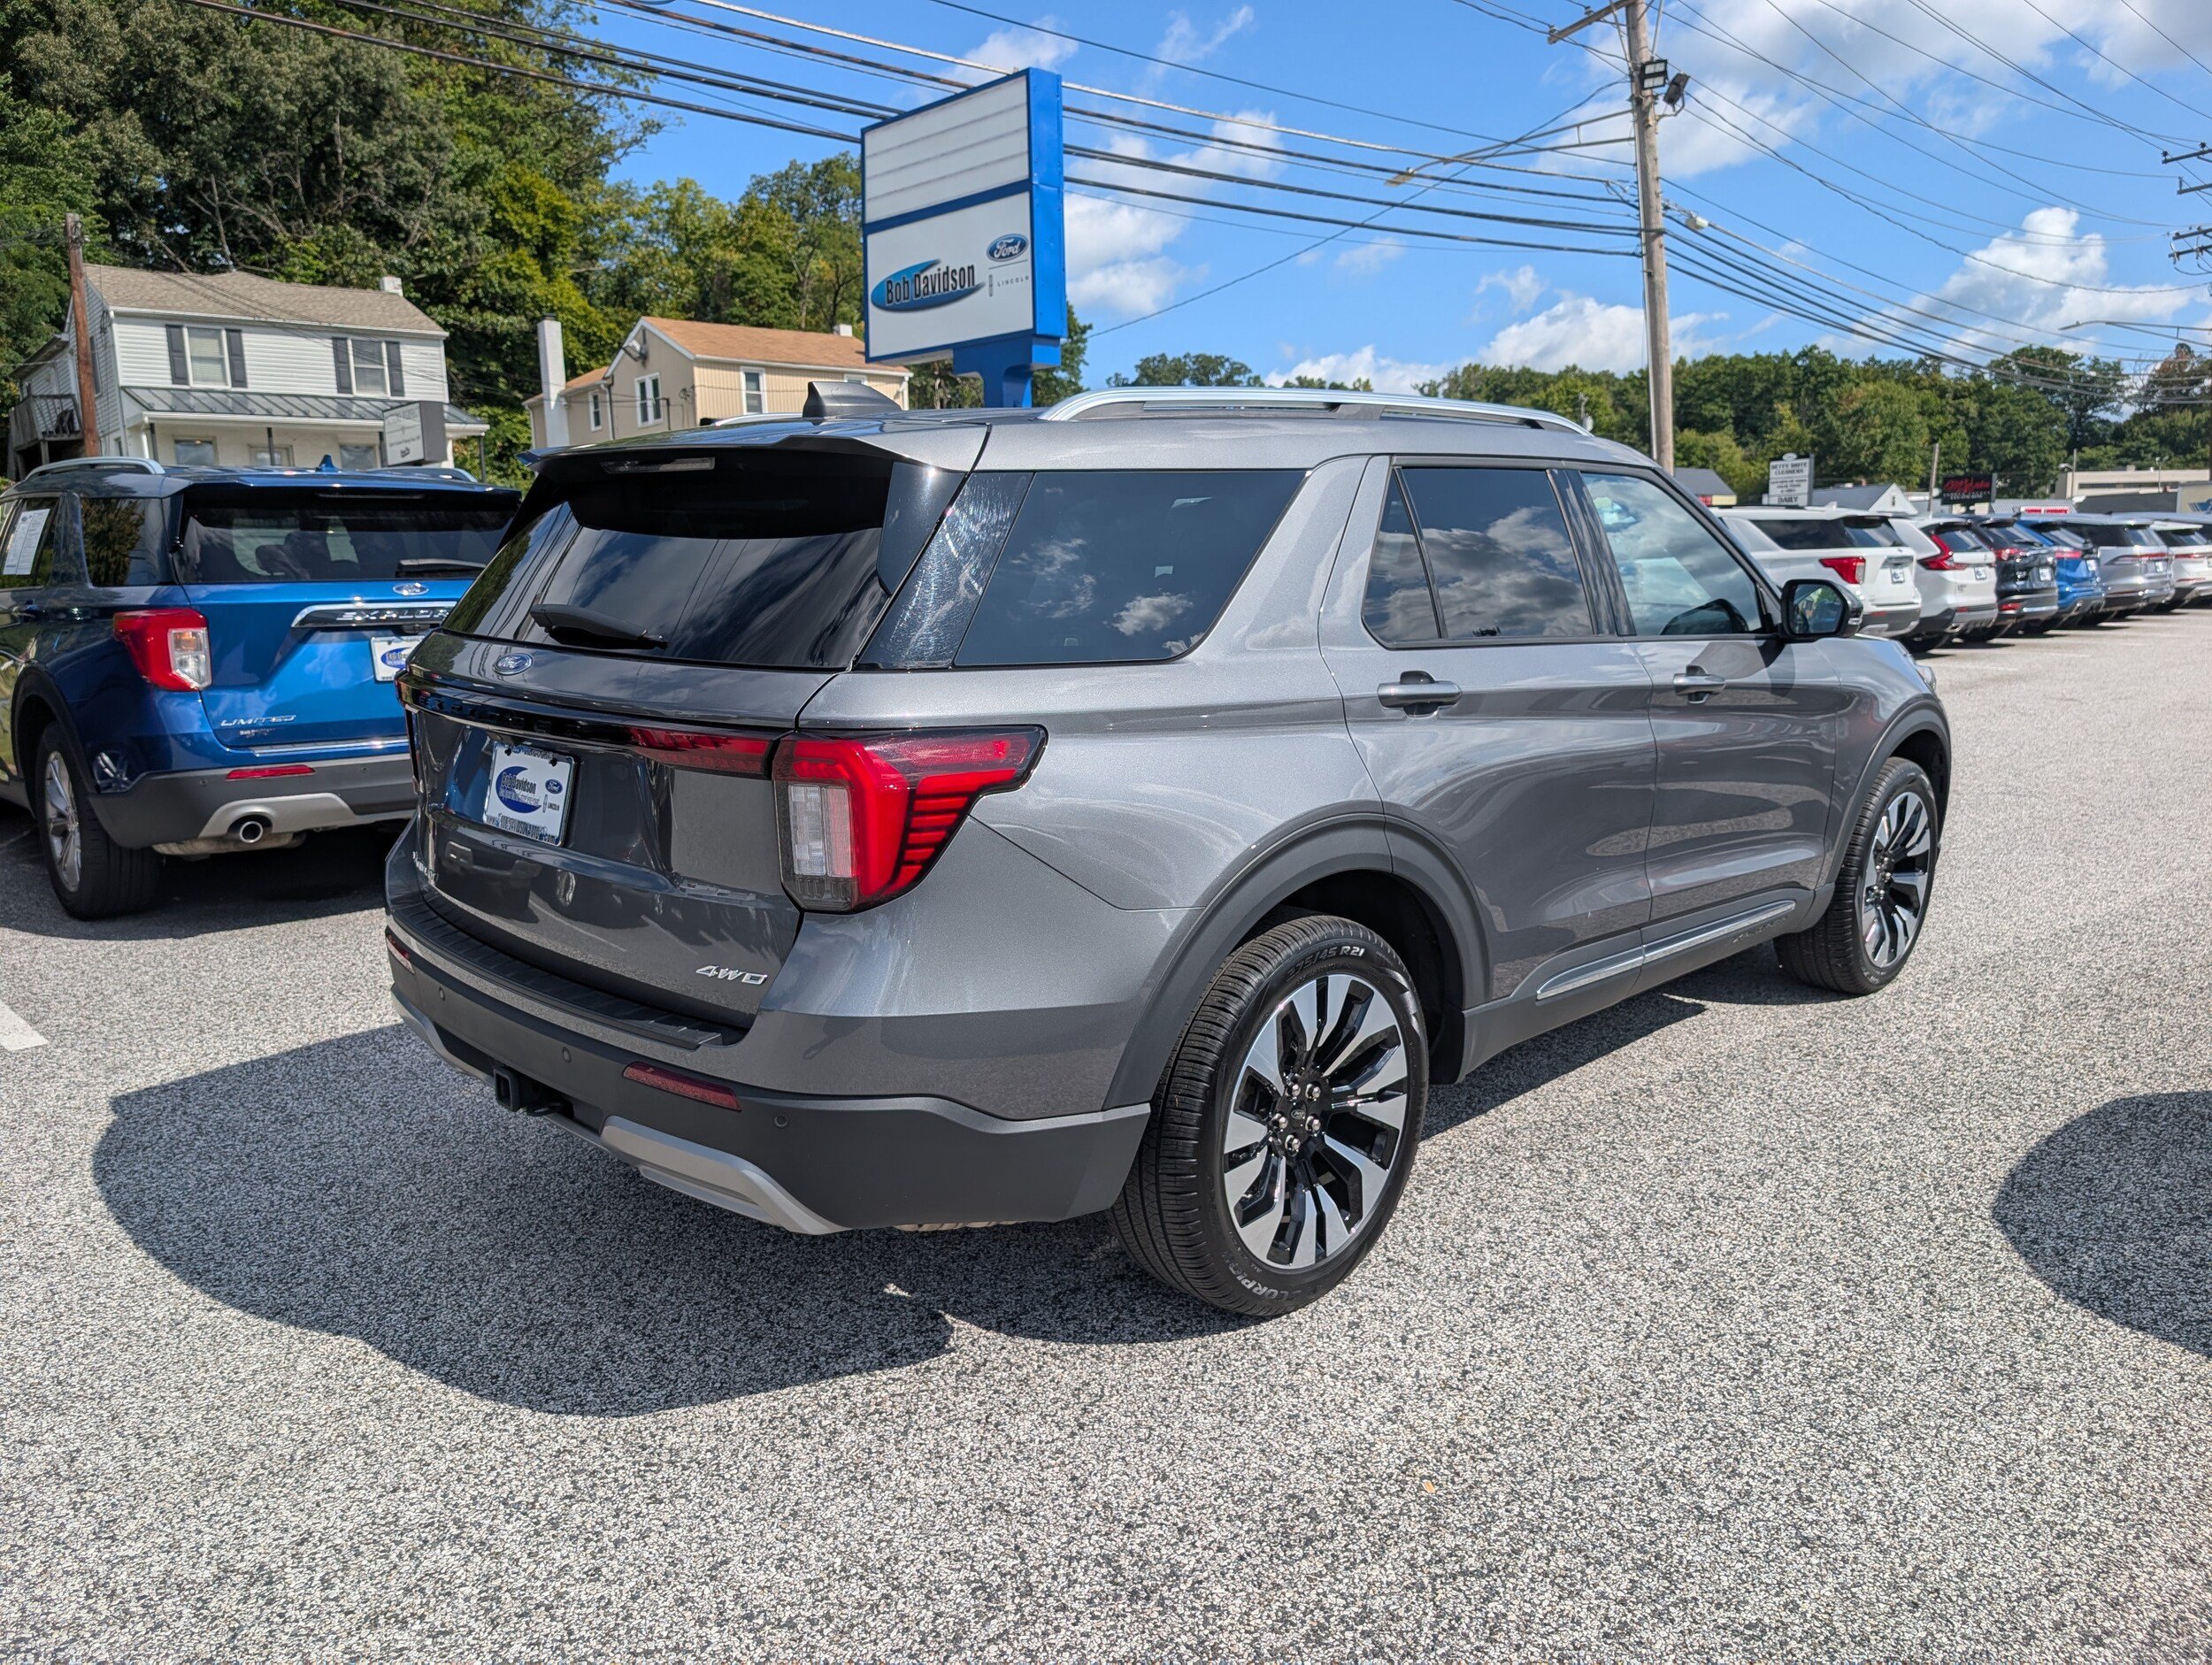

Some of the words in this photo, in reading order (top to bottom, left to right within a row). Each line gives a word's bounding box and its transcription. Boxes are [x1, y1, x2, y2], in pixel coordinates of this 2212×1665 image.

[994, 238, 1021, 258] Ford
[887, 276, 910, 305] Bob
[914, 265, 975, 298] Davidson
[220, 714, 296, 727] LIMITED
[502, 771, 514, 790] Bob
[513, 775, 537, 794] Davidson
[1340, 946, 1365, 957] R21
[695, 965, 768, 985] 4WD
